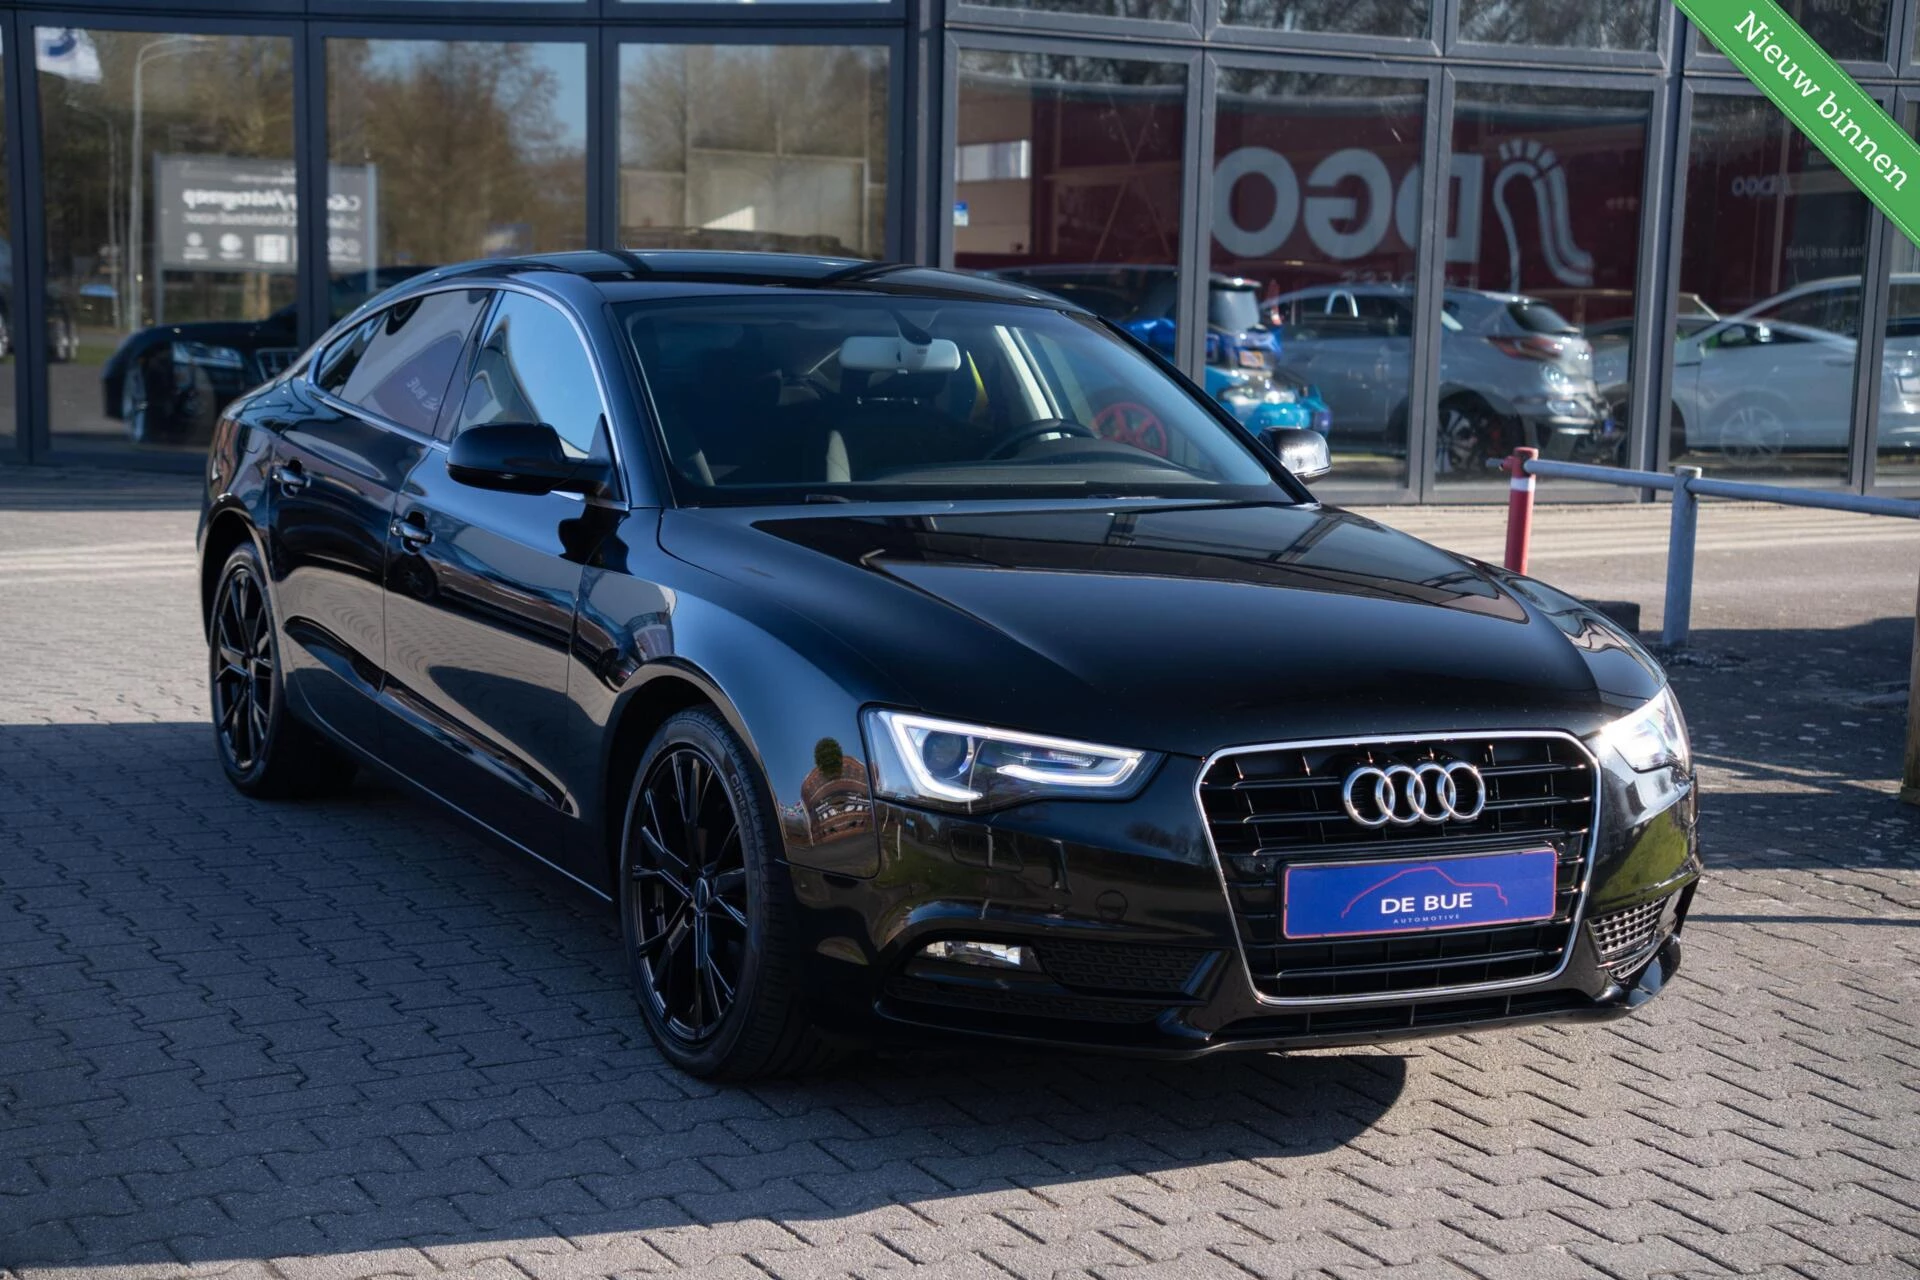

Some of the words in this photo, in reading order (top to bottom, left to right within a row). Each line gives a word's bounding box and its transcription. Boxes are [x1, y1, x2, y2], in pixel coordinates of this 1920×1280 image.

[1381, 896, 1415, 914] DE
[1424, 892, 1473, 911] BUE
[1393, 913, 1460, 924] AUTOMOTIVE
